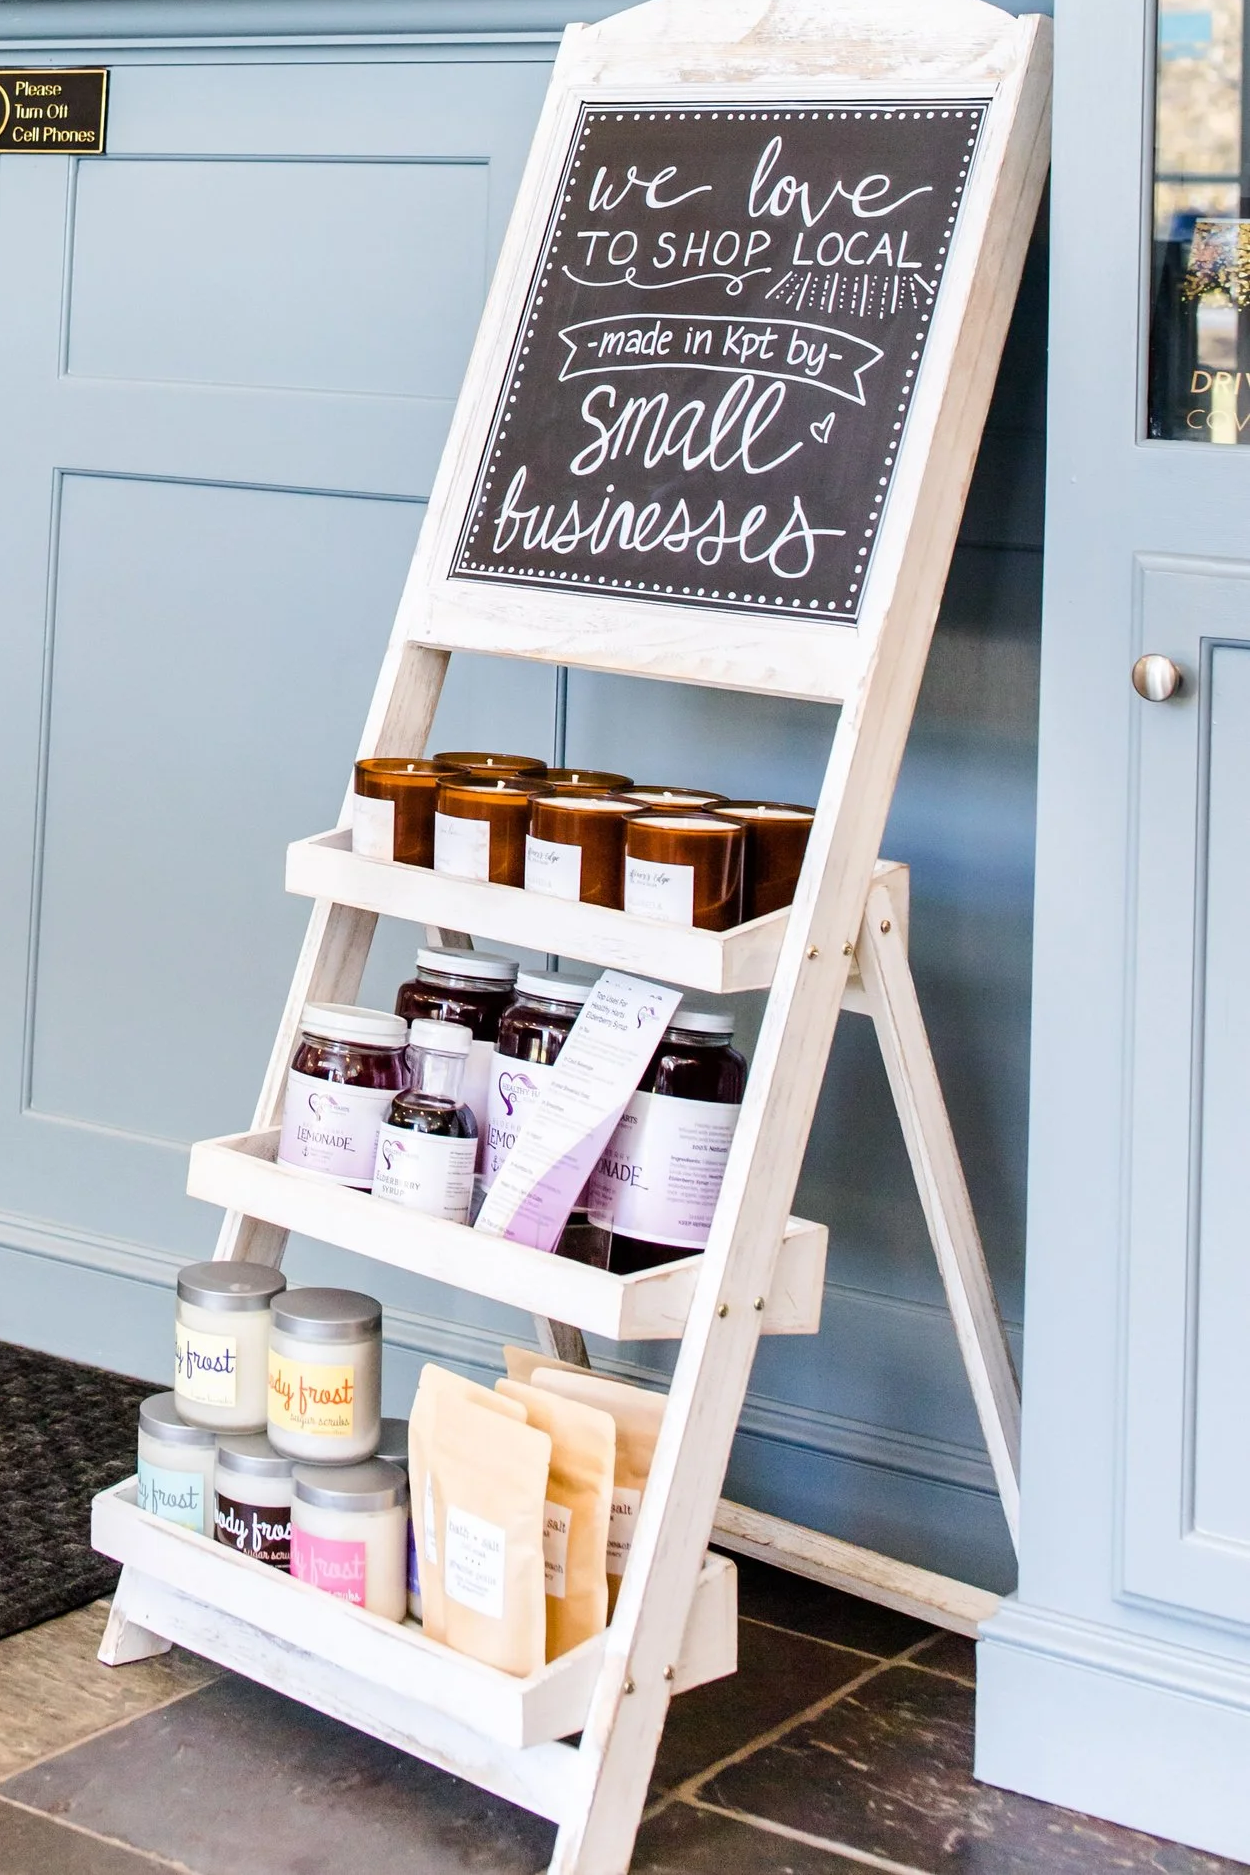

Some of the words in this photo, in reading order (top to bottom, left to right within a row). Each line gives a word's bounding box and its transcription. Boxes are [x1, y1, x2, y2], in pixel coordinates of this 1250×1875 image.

[15, 81, 62, 97] Please
[14, 103, 43, 119] Turn
[46, 103, 69, 119] Off
[12, 127, 39, 142] Cell
[43, 127, 95, 143] Phones
[587, 164, 712, 214] we
[748, 135, 933, 228] love
[577, 231, 638, 267] TO
[652, 230, 772, 269] SHOP
[793, 230, 923, 268] LOCAL
[683, 326, 712, 355] in
[492, 466, 847, 579] businesses
[591, 1001, 610, 1015] Healthy
[597, 990, 606, 1001] Top
[606, 995, 619, 1005] Uses
[619, 998, 628, 1007] For
[585, 1010, 613, 1028] Elderberry
[502, 1083, 530, 1097] HEALTHY
[297, 1125, 356, 1153] LEMONADE
[375, 1170, 421, 1192] ELDERBRRY
[382, 1183, 406, 1198] SYRUP
[187, 1340, 237, 1379] frost
[268, 1369, 295, 1411] ody
[298, 1375, 355, 1415] frost
[290, 1413, 316, 1429] sugar
[318, 1414, 351, 1427] scrubs
[151, 1478, 200, 1515] frost
[448, 1519, 470, 1540] bath
[481, 1536, 500, 1553] salt
[547, 1518, 566, 1534] salt
[310, 1545, 366, 1586] frost
